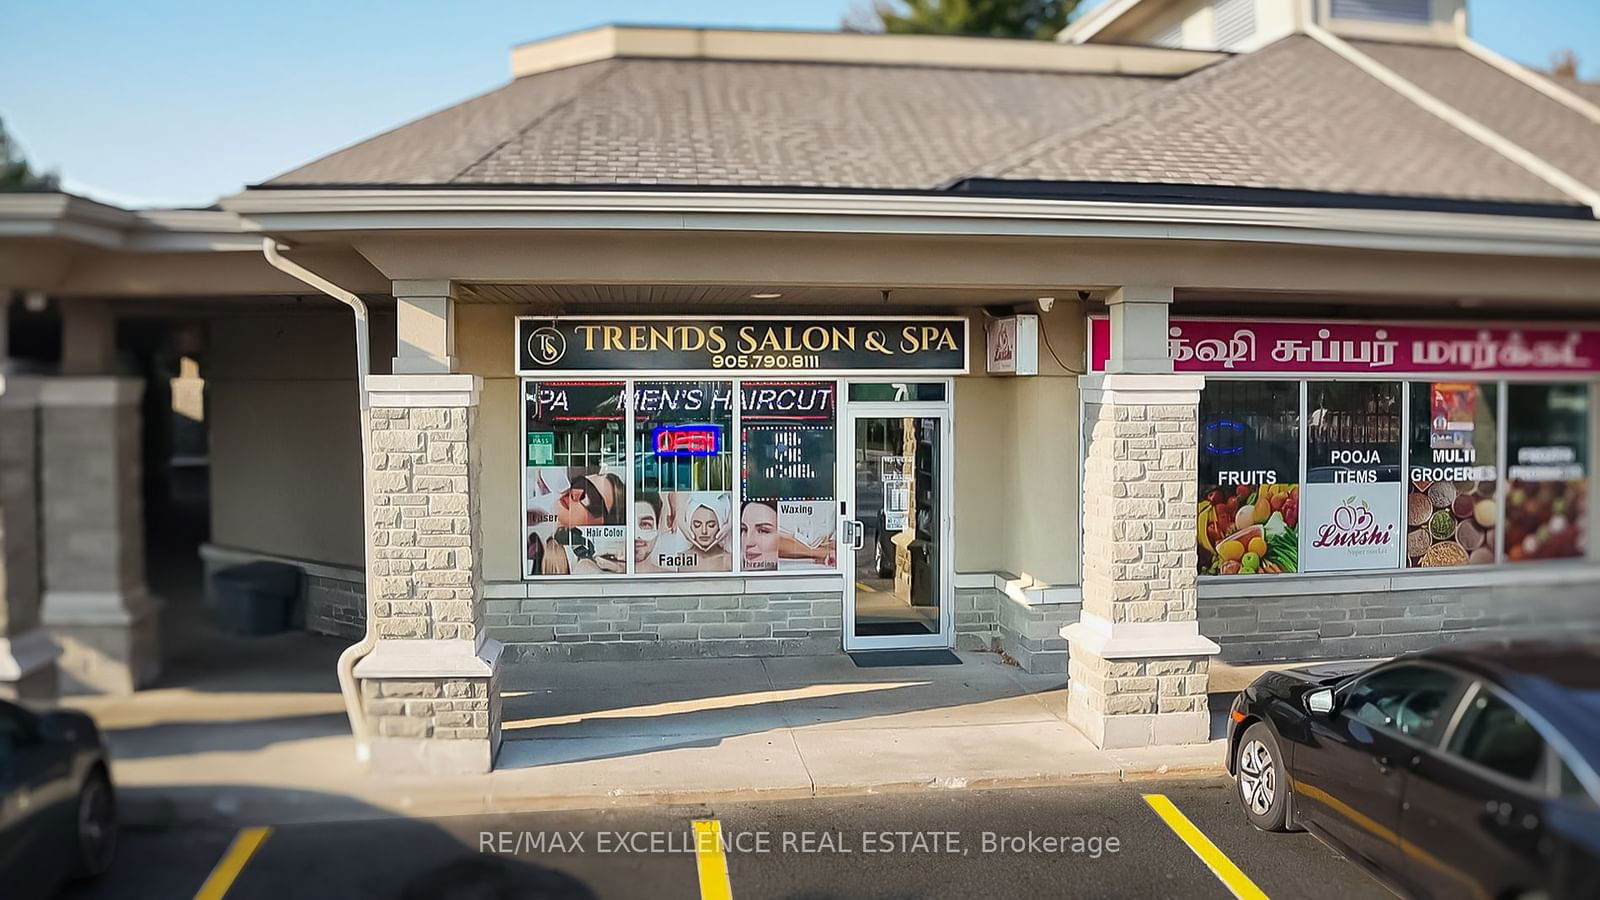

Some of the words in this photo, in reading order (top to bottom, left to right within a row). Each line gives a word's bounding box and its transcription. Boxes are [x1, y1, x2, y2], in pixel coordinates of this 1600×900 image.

[574, 324, 726, 354] TRENDS
[737, 325, 856, 354] SALON
[864, 328, 894, 355] &
[900, 325, 958, 354] SPA
[712, 354, 820, 369] 905.790.8111
[616, 389, 703, 411] MEN'S
[710, 389, 832, 411] HAIRCUT
[1331, 450, 1381, 464] POOJA
[1432, 449, 1476, 463] MULTI
[1218, 470, 1277, 486] FRUITS
[1334, 470, 1377, 484] ITEMS
[780, 505, 813, 515] Waxing
[586, 528, 602, 537] Hair
[603, 528, 624, 537] Color
[658, 554, 698, 567] Facial
